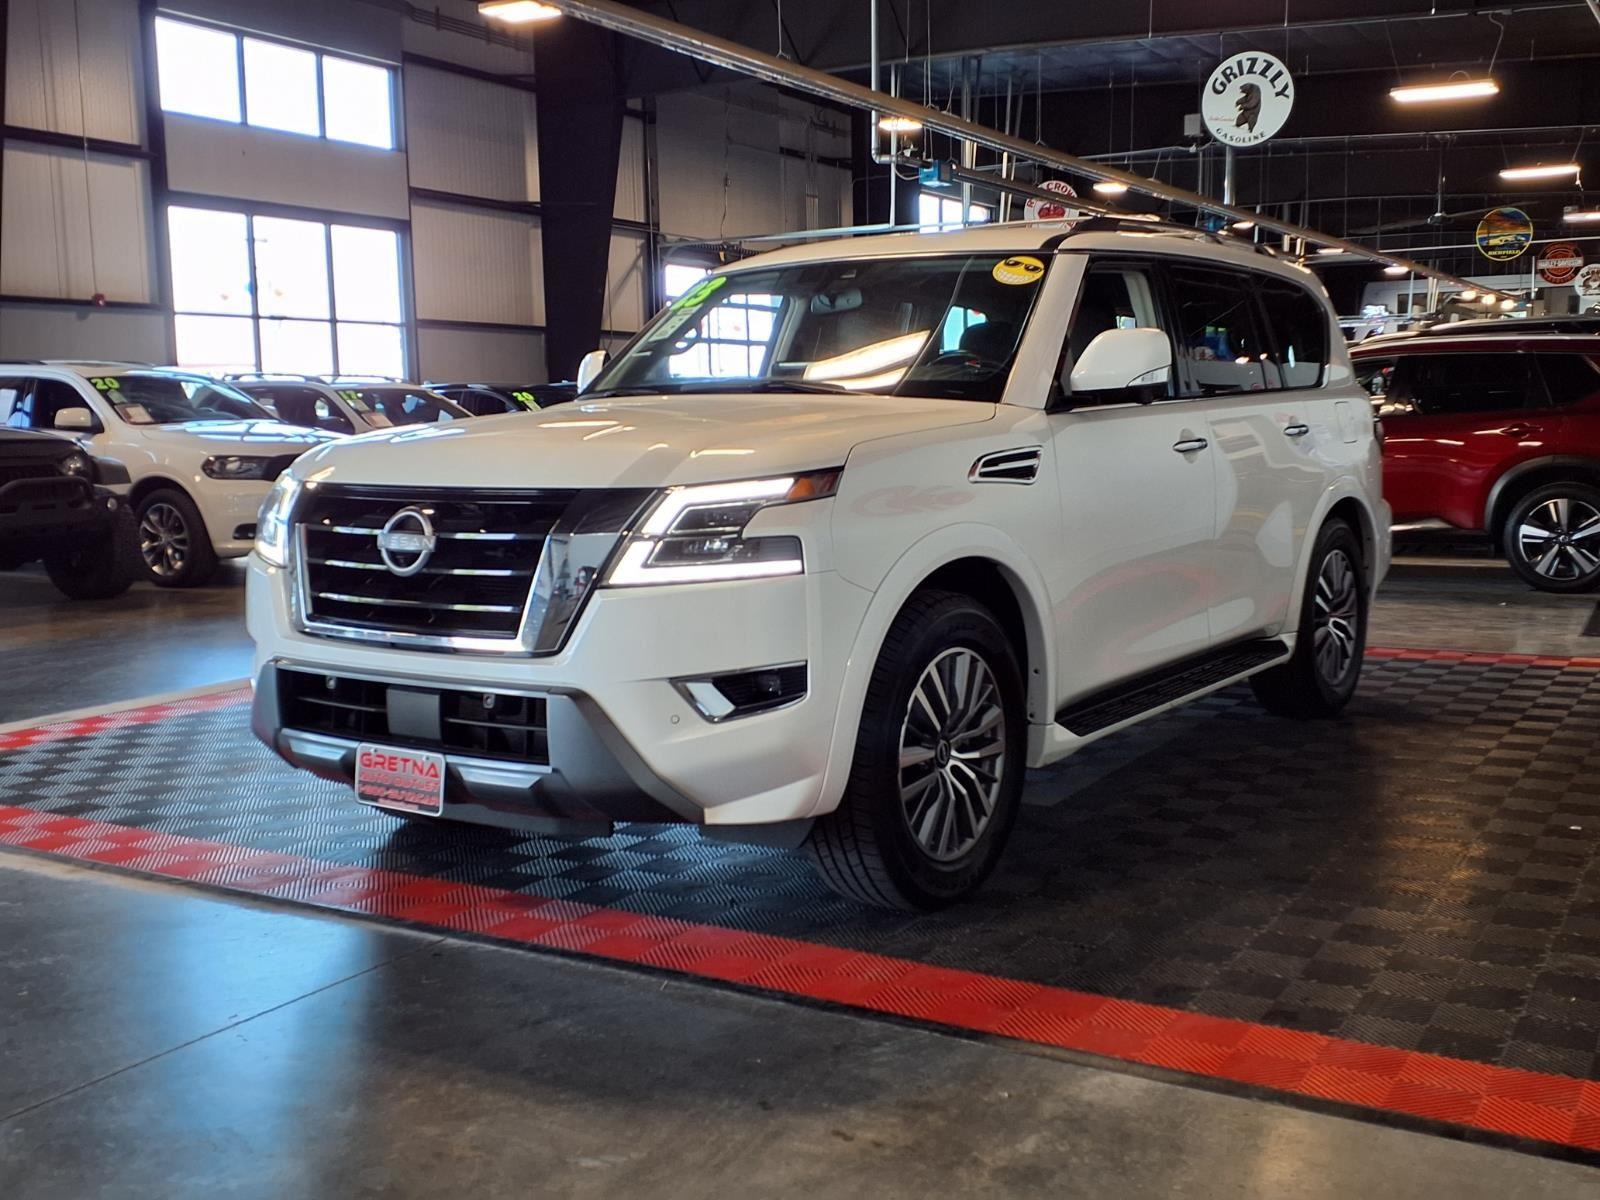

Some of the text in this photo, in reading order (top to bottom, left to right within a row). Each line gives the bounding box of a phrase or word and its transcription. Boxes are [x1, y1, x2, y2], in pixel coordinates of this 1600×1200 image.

[1212, 57, 1290, 99] GRIZZLY
[1216, 128, 1265, 143] GASOLINE
[90, 377, 120, 390] 20
[512, 392, 534, 401] 20
[379, 535, 435, 549] NISSAN
[361, 752, 439, 778] GRETNA
